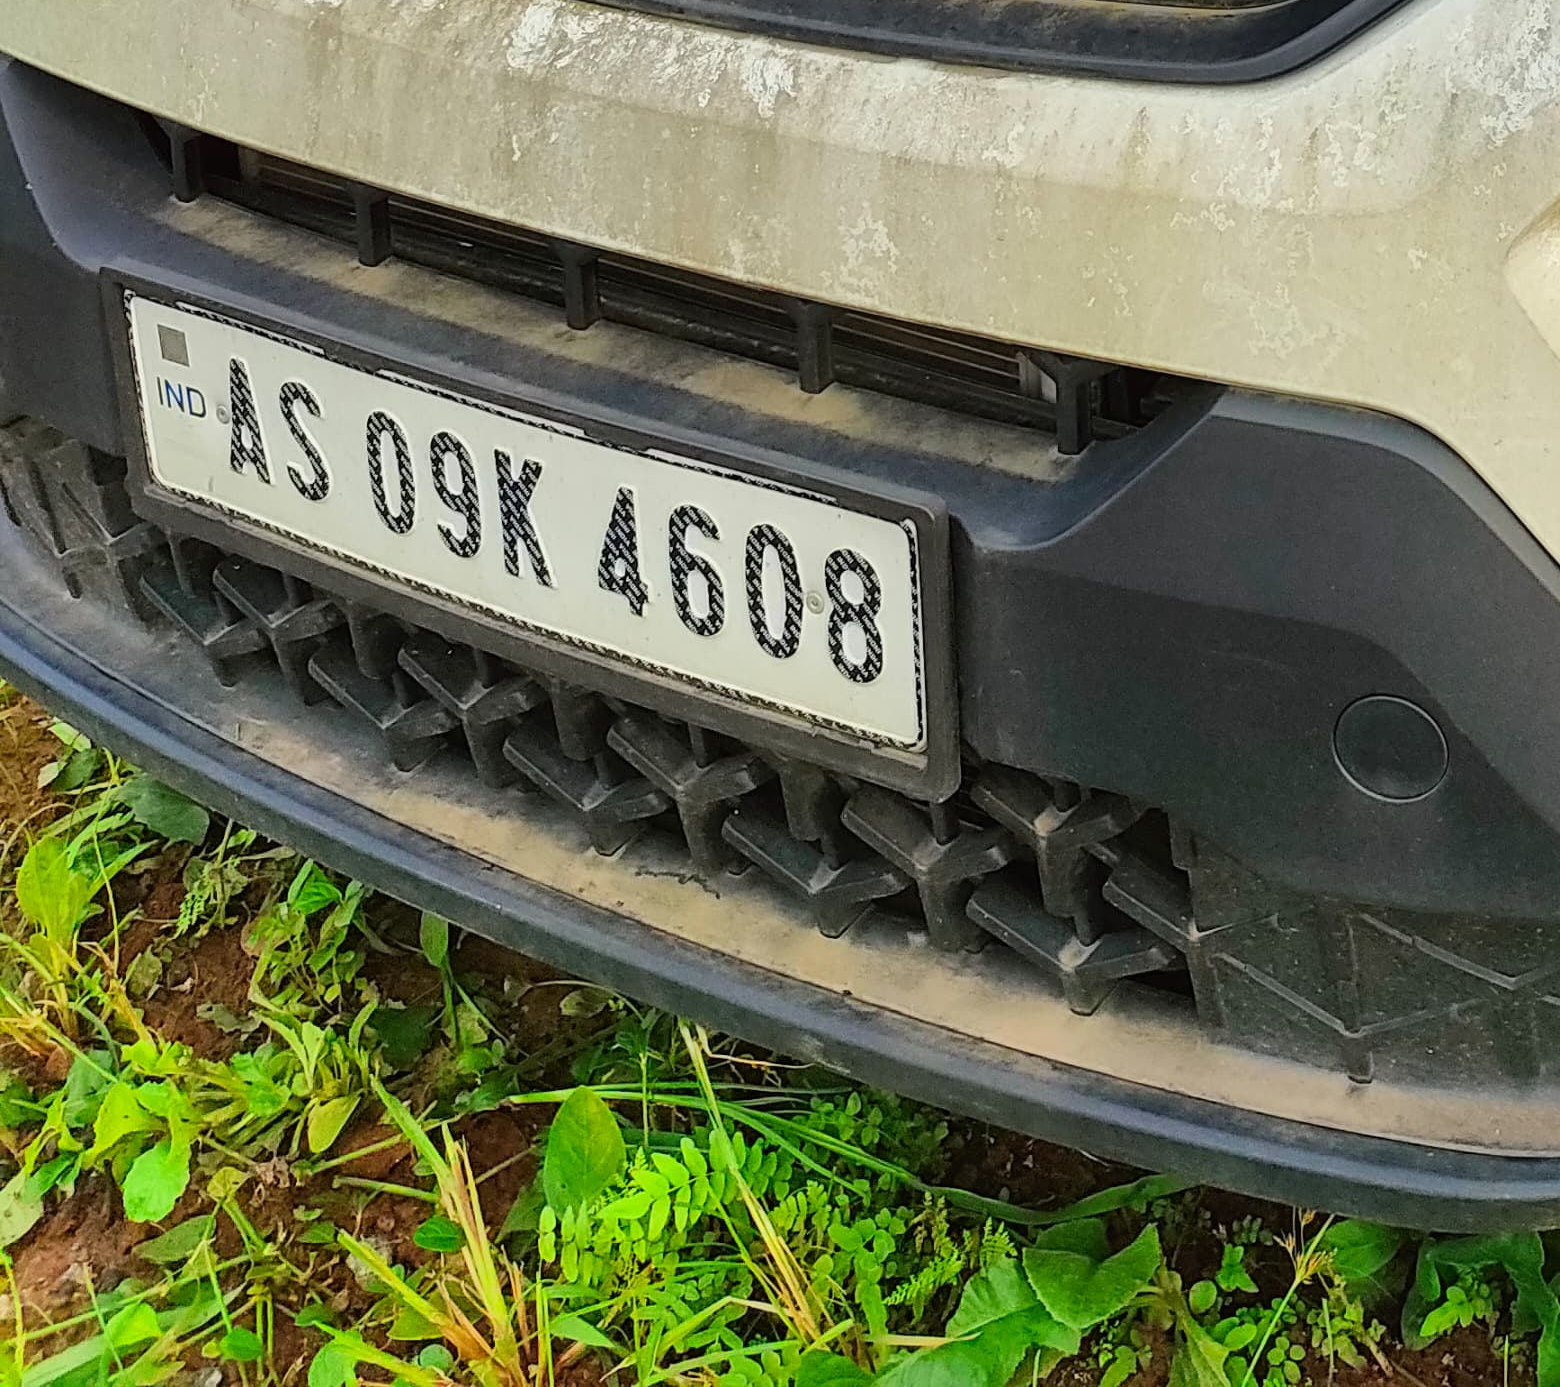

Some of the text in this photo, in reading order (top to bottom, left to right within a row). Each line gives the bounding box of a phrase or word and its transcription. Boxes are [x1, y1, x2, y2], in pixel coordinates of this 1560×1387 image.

[156, 375, 208, 419] IND
[228, 356, 887, 685] AS 09K 4608
